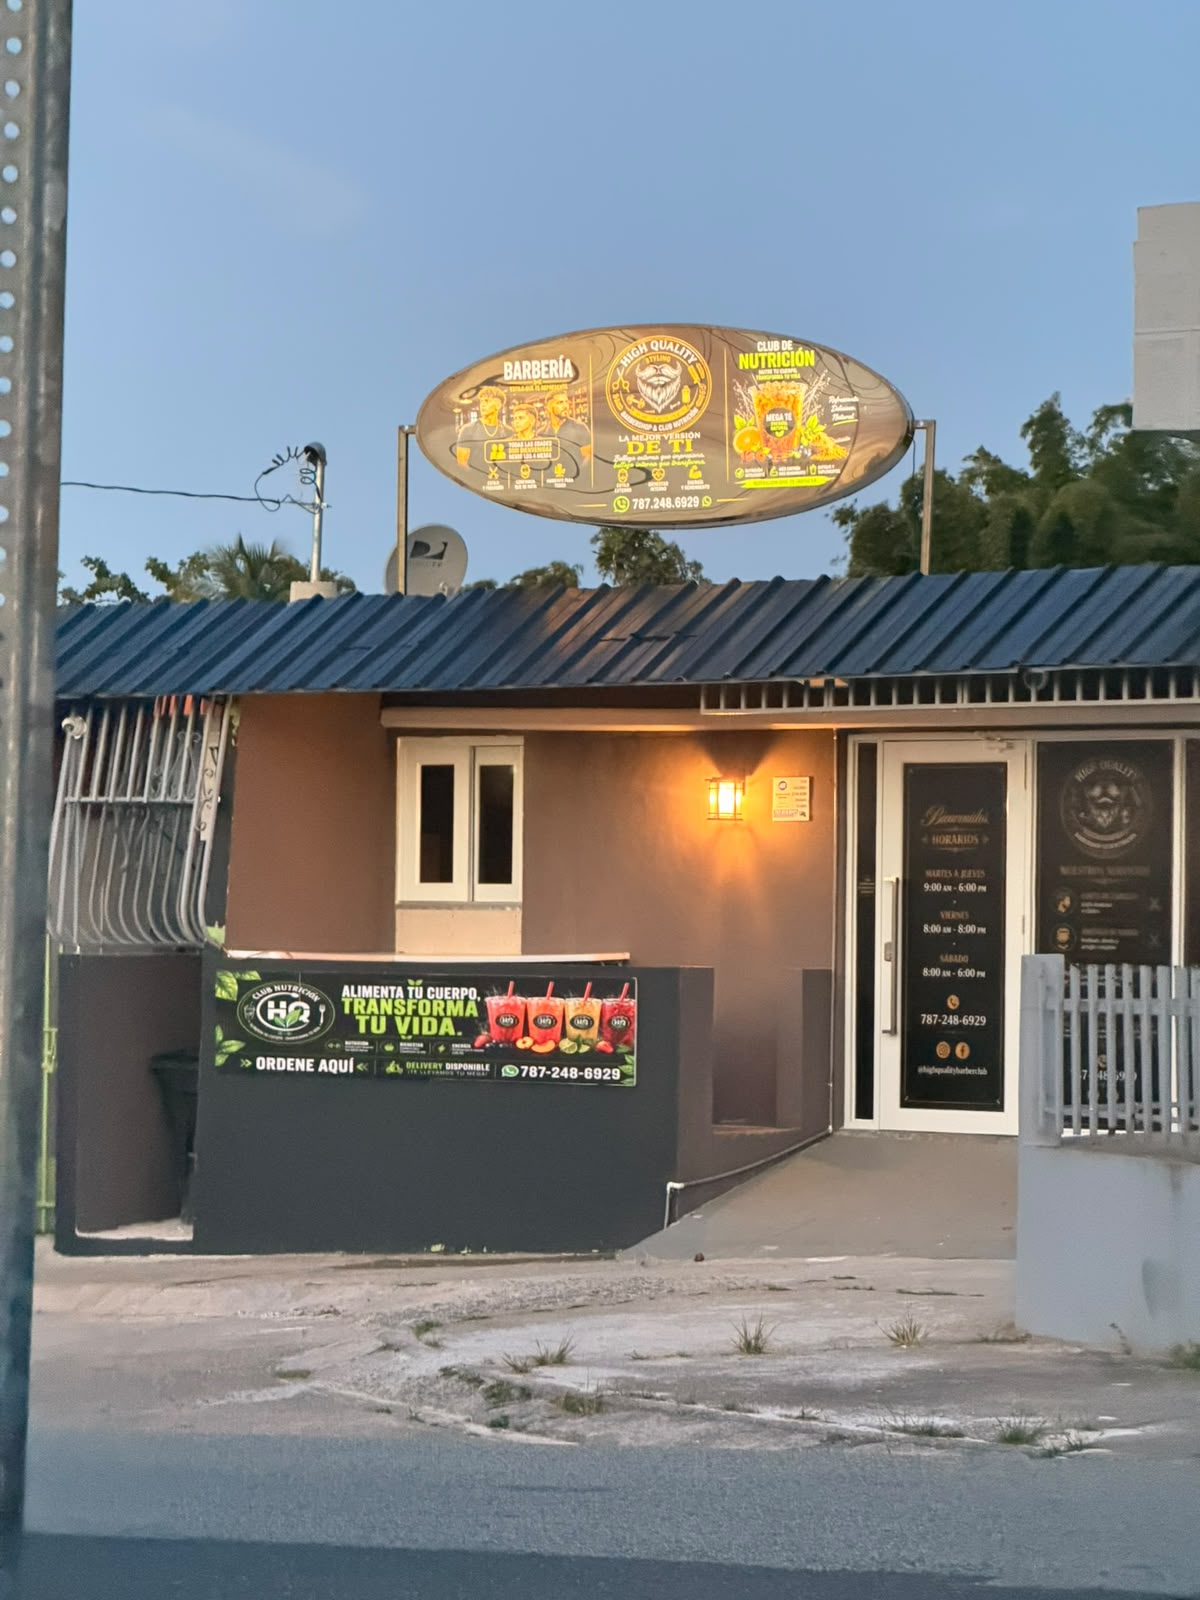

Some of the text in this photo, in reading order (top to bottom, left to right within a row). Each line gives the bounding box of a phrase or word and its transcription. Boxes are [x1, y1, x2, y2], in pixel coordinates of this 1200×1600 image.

[757, 340, 793, 352] CLUB DE
[620, 340, 698, 366] HIGH QUALITY
[738, 347, 815, 370] NUTRICIÓN
[644, 355, 671, 364] STYLING
[504, 354, 573, 380] BARBERÍA
[766, 413, 784, 422] MEGA
[652, 424, 658, 432] &
[632, 434, 660, 442] MEJOR
[664, 432, 700, 440] VERSIÓN
[626, 438, 693, 454] DE TI
[632, 496, 700, 509] 787.248.6929
[932, 834, 979, 845] HORARIOS
[954, 869, 959, 878] A
[924, 882, 942, 892] 9:00
[958, 882, 976, 892] 6:00
[923, 924, 941, 934] 8:00
[942, 926, 952, 934] AM
[958, 924, 976, 934] 8:00
[923, 968, 941, 977] 8:00
[957, 968, 976, 977] 6:00
[976, 970, 986, 978] PM
[252, 984, 320, 1002] CLUB NUTRICIÓN
[342, 985, 481, 1002] ALIMENTA TU CUERPO,
[267, 1000, 310, 1023] HQ
[342, 998, 478, 1017] TRANSFORMA
[355, 1016, 462, 1036] TU VIDA.
[920, 1014, 986, 1026] 787-248-6929
[256, 1056, 354, 1074] ORDENE AQUÍ
[406, 1062, 490, 1071] DELIVERY DISPONIBLE
[521, 1066, 620, 1080] 787-248-6929
